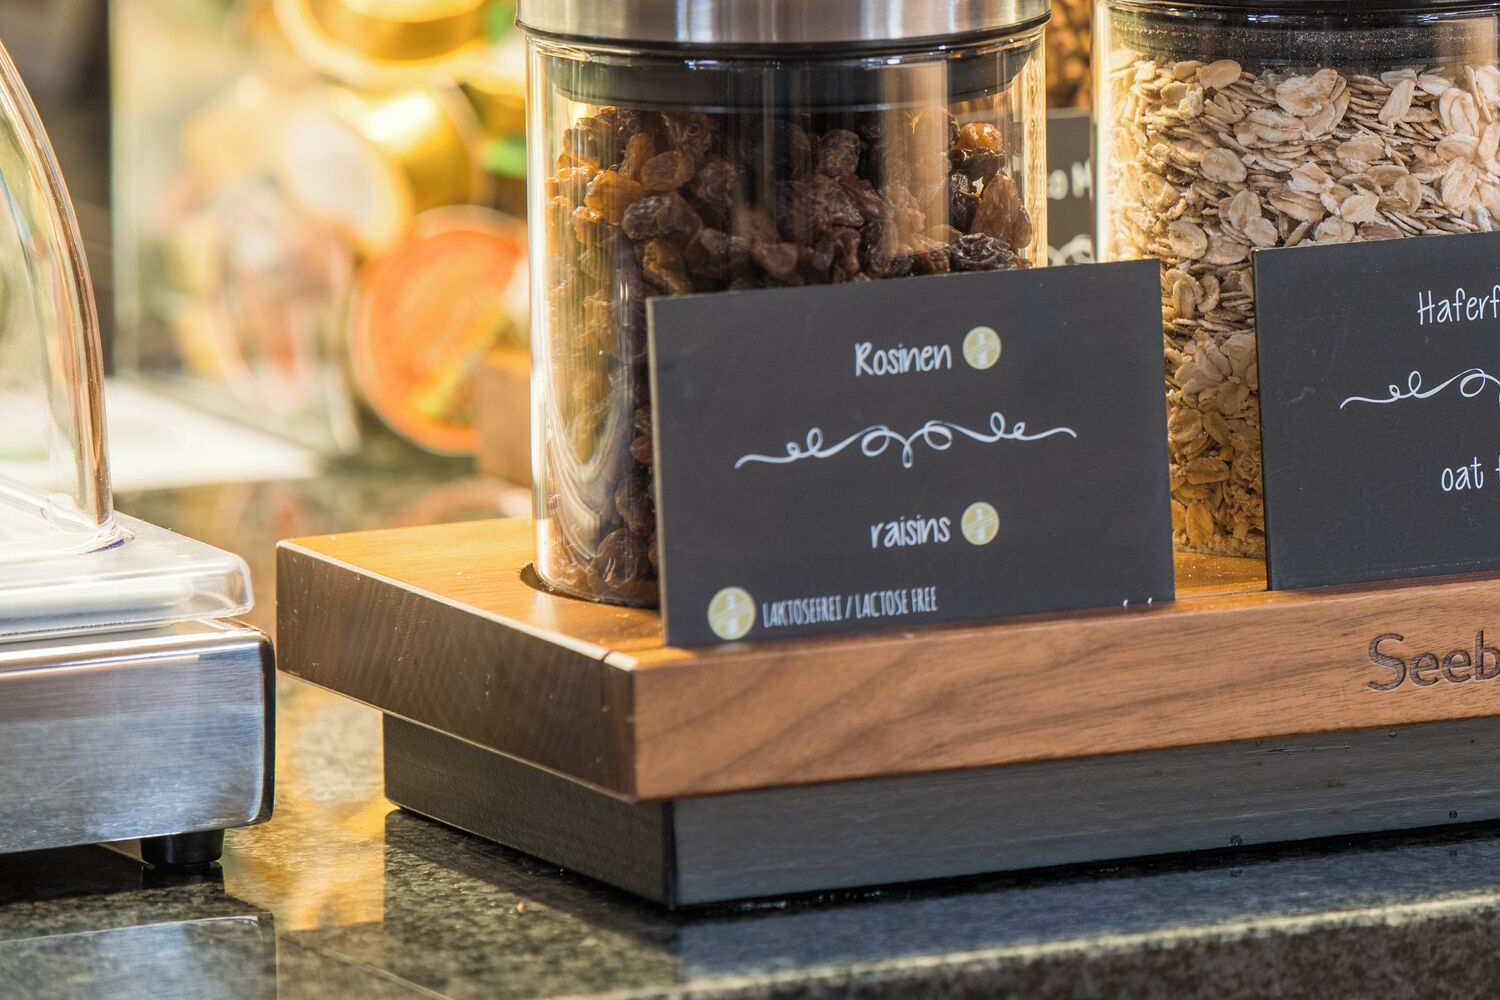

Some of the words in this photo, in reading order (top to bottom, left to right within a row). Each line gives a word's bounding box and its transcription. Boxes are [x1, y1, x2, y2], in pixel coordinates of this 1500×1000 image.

[854, 341, 953, 377] Rosinen
[1441, 456, 1484, 492] oat
[870, 514, 952, 549] raisins
[762, 595, 843, 628] LAKTOSEFREI
[855, 589, 909, 619] LACTOSE
[910, 586, 938, 613] FREE
